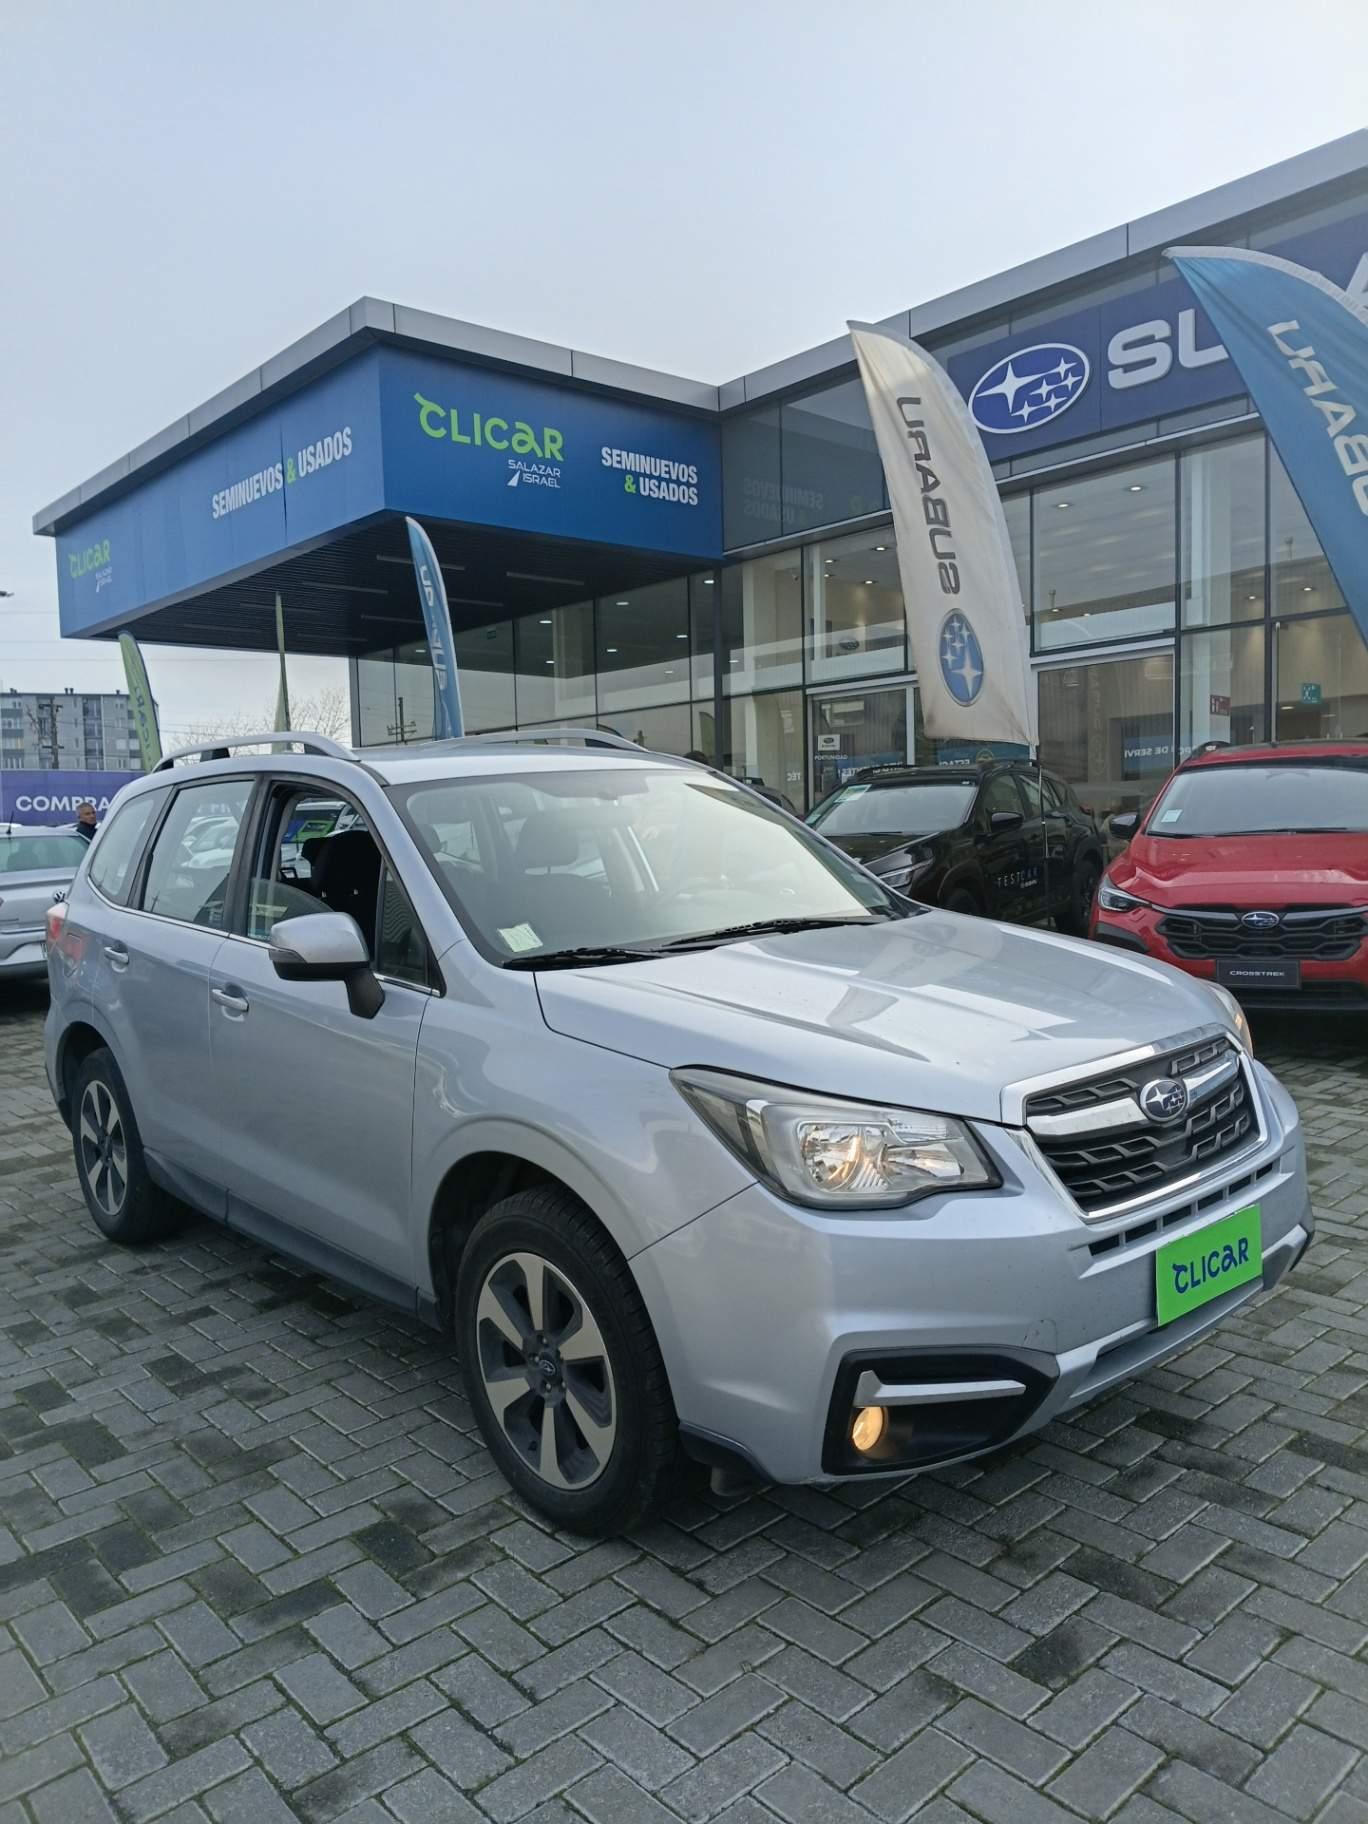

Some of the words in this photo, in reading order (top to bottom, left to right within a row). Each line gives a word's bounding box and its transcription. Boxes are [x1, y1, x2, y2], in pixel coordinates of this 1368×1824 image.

[212, 462, 284, 519] SEMINUEVOS
[287, 457, 297, 484] &
[298, 426, 352, 478] USADOS
[508, 459, 561, 478] SALAZAR
[522, 473, 561, 489] ISRAEL
[601, 446, 698, 484] SEMINUEVOS
[624, 474, 637, 494] &
[639, 479, 698, 506] USADOS
